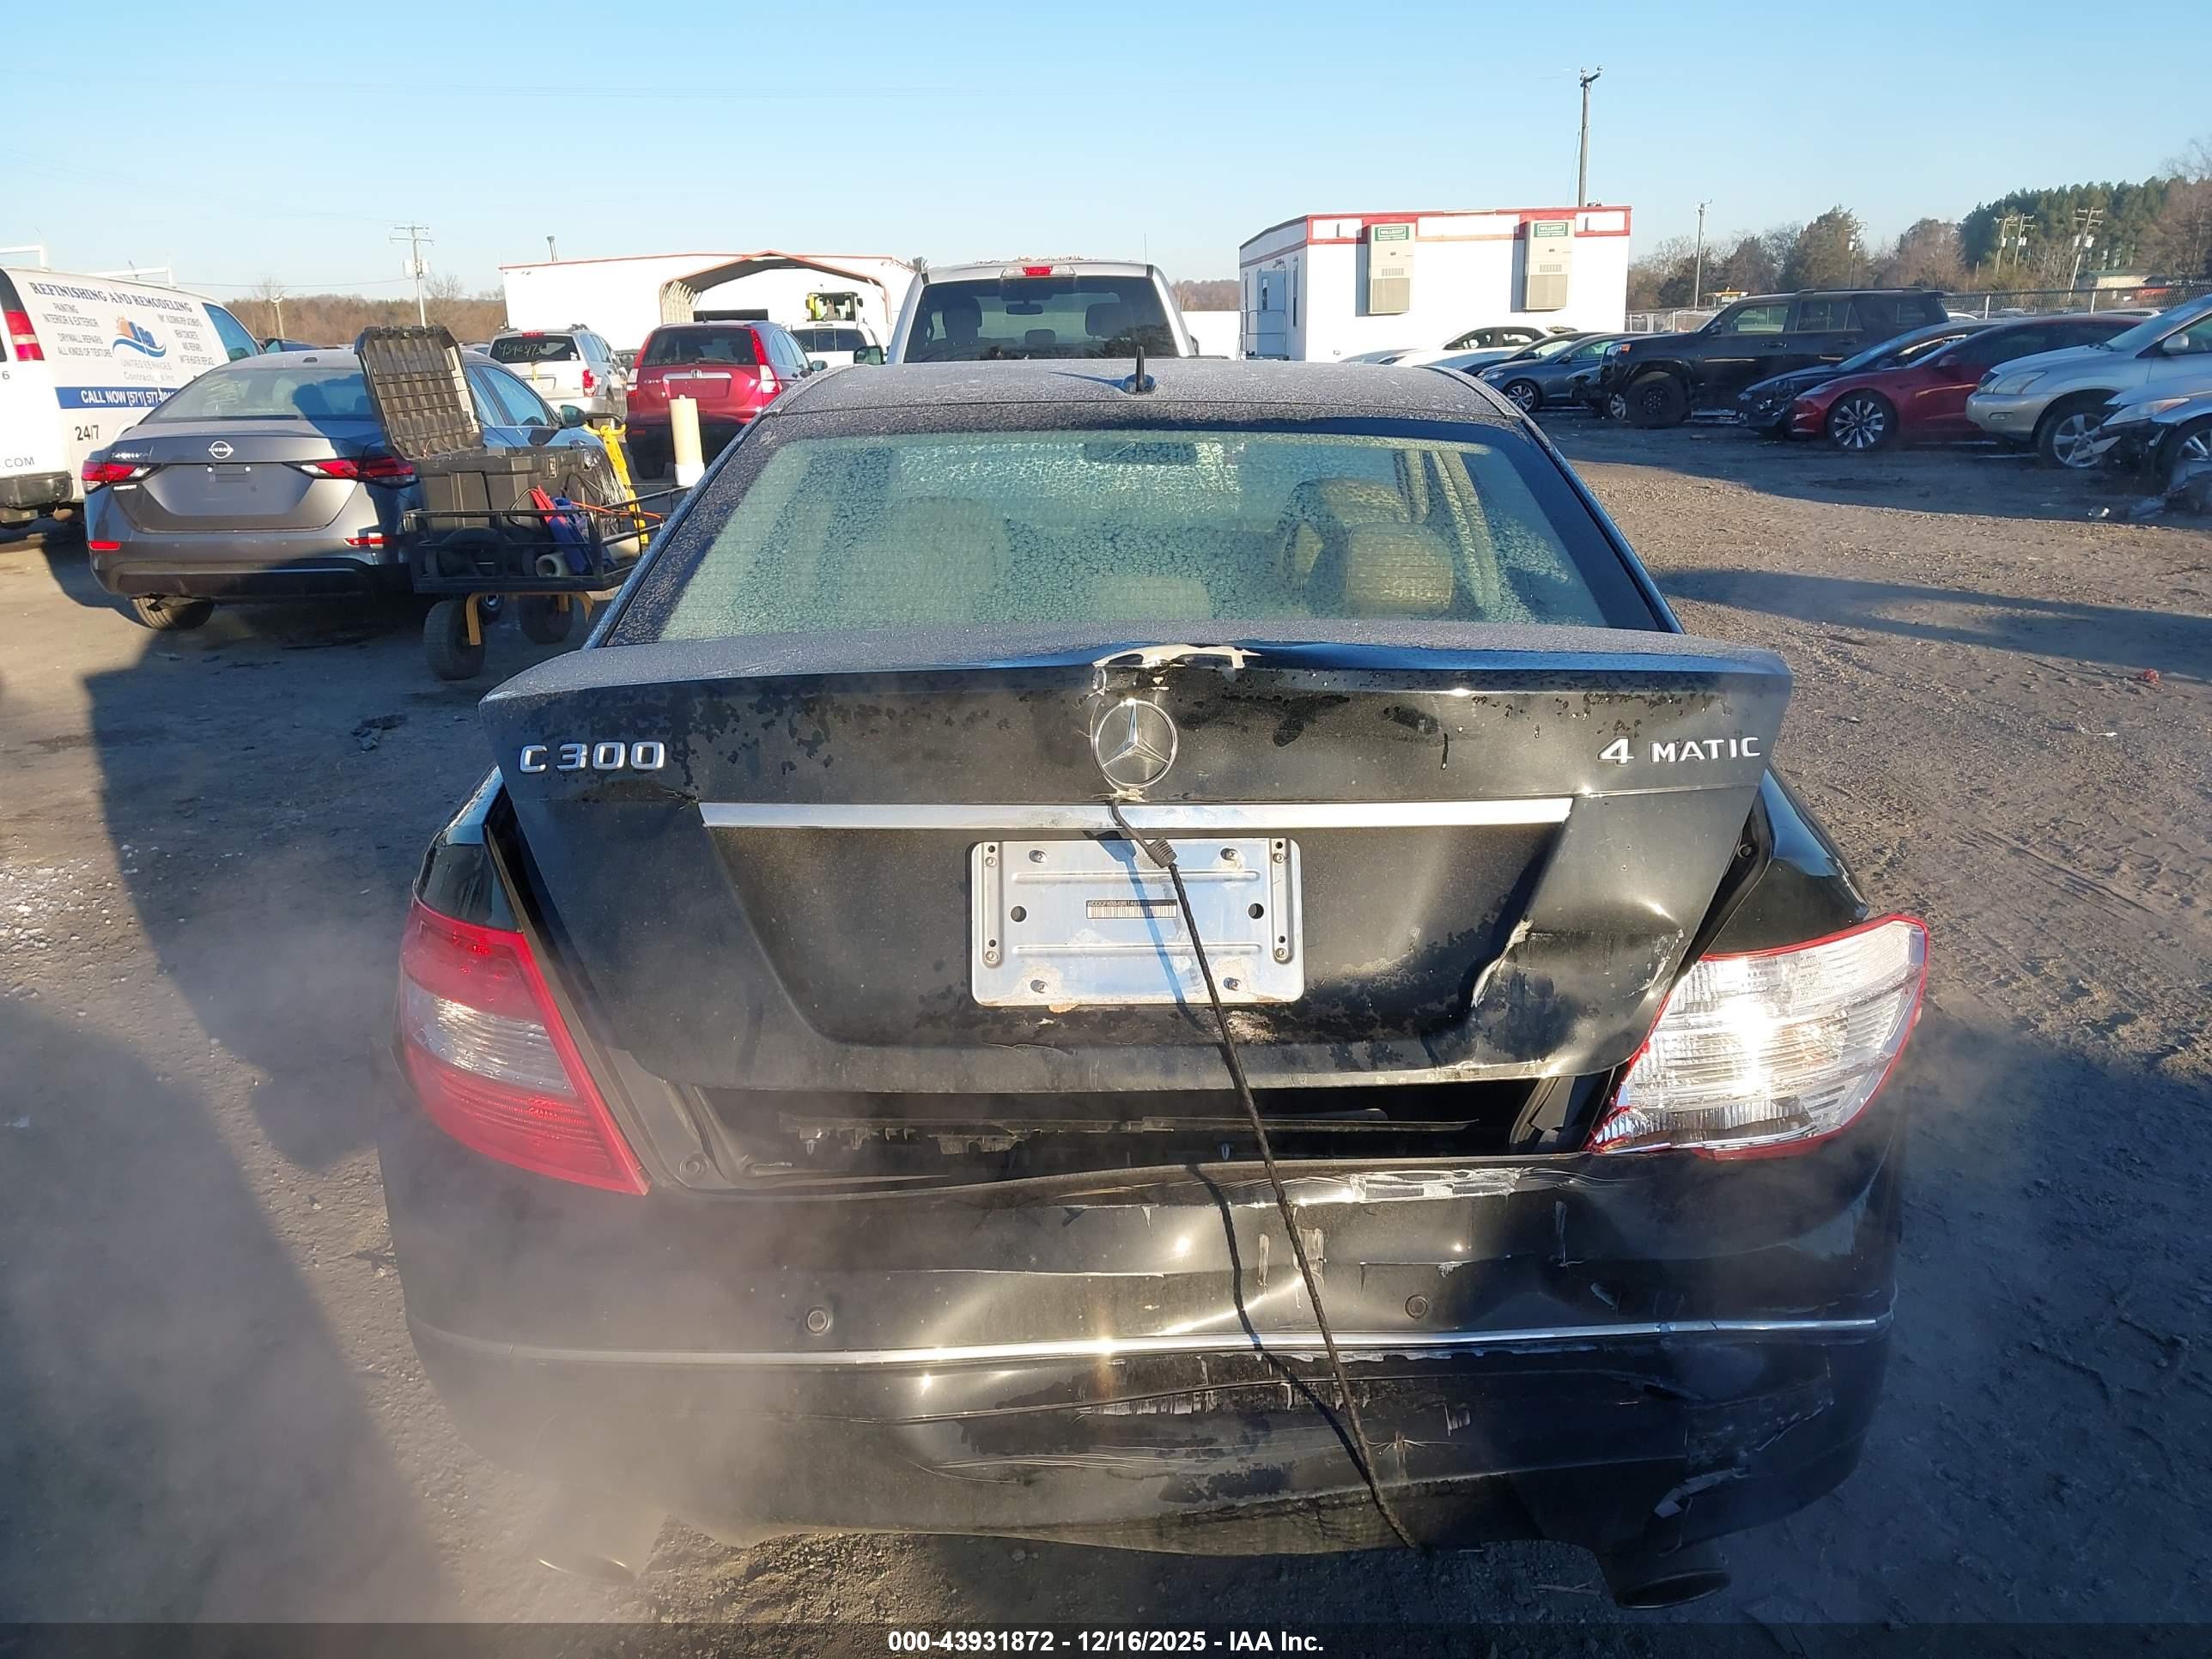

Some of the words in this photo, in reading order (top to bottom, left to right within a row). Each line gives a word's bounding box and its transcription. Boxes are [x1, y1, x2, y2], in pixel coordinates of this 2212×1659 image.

[27, 282, 107, 301] REFINISHING
[108, 292, 132, 304] AND
[131, 295, 192, 313] REMODELING
[2, 370, 10, 380] 6
[81, 390, 106, 404] CALL
[105, 391, 127, 404] NOW
